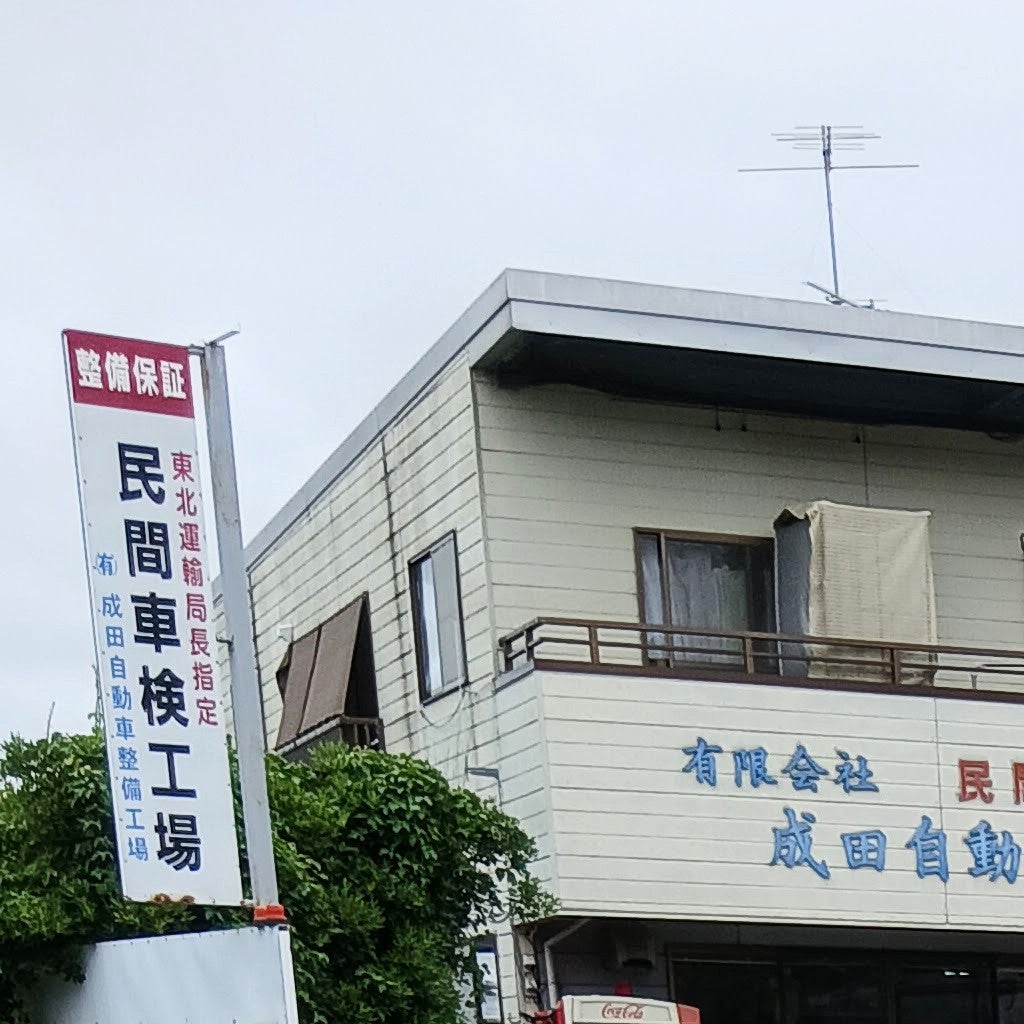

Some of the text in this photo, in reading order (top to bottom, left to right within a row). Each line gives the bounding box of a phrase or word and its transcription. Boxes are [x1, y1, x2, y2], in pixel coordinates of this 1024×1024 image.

[75, 348, 186, 399] 整備保証
[117, 442, 203, 872] 民間車検工場
[171, 451, 218, 726] 東北運輸局長指定
[682, 736, 880, 794] 有限会社
